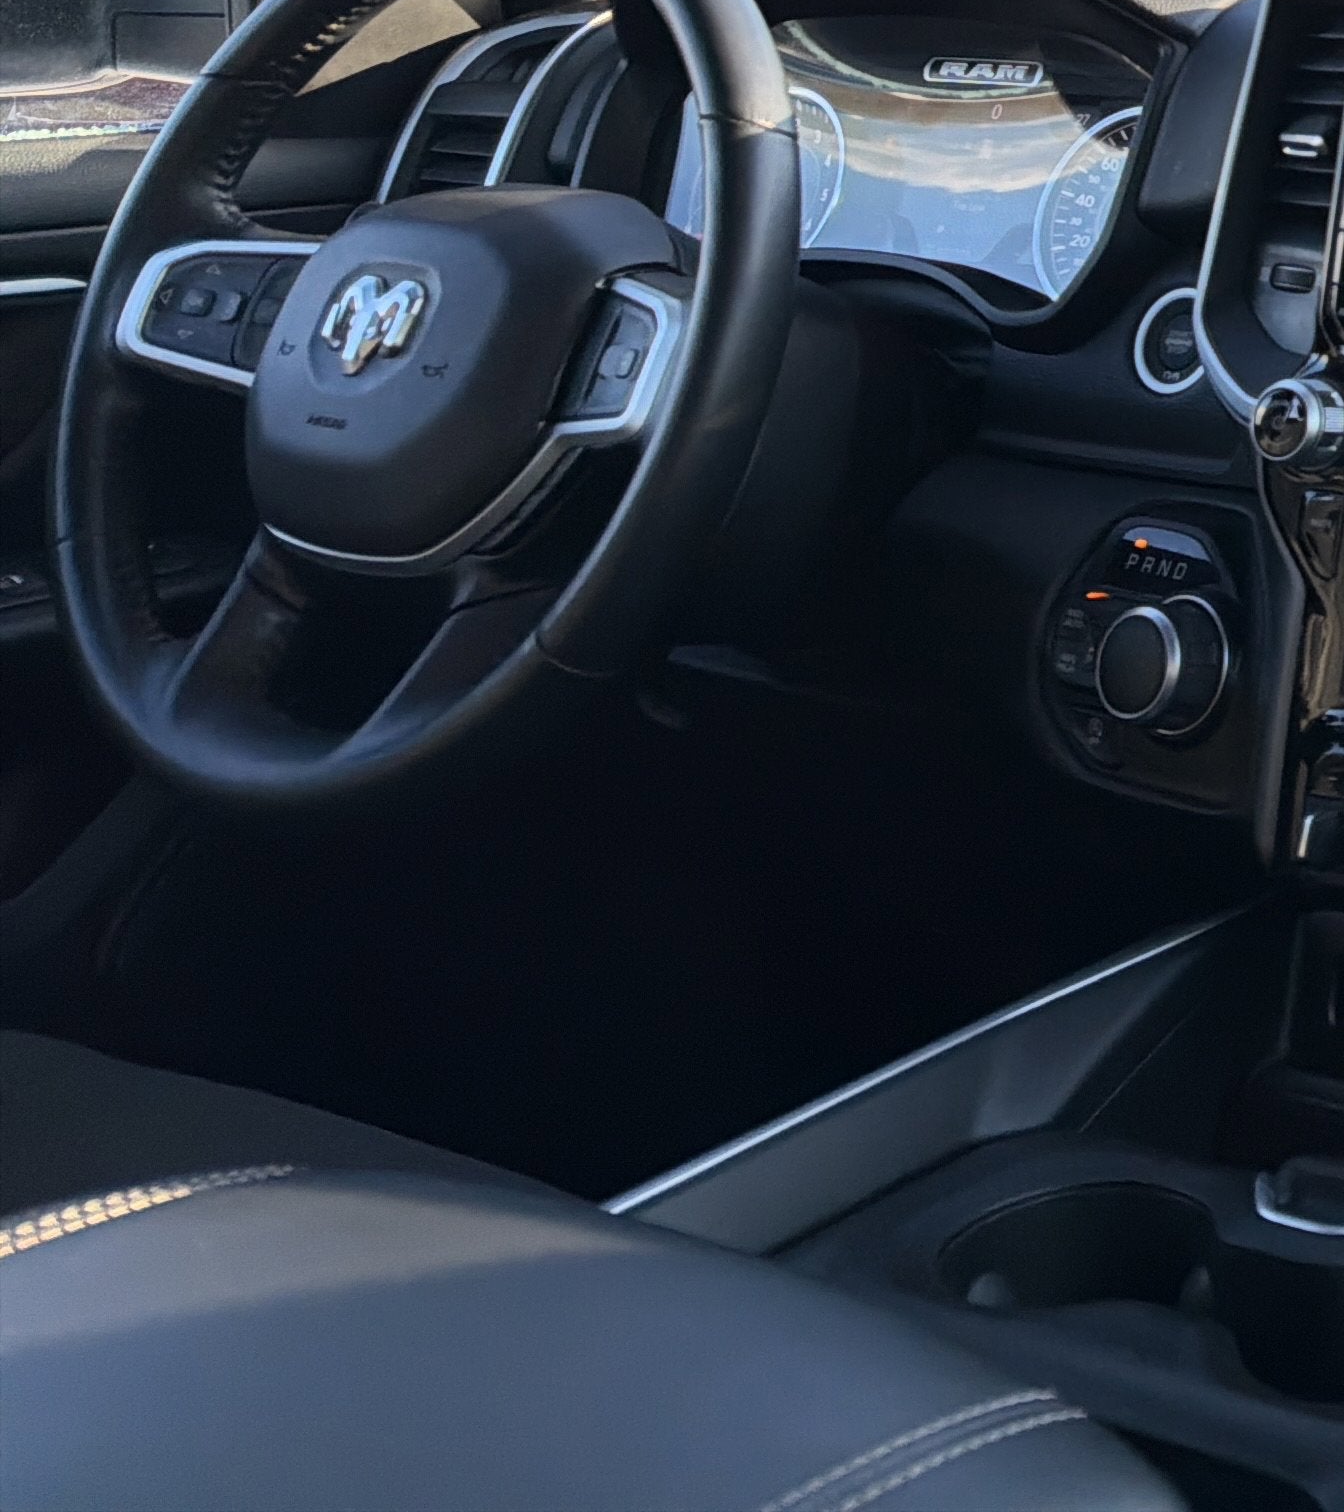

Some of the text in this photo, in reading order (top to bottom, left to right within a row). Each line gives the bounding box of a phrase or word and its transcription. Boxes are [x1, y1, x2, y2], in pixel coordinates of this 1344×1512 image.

[938, 61, 1030, 81] RAM
[991, 103, 1003, 120] 0
[1100, 157, 1119, 172] 60
[1075, 193, 1096, 208] 40
[1069, 234, 1091, 248] 20
